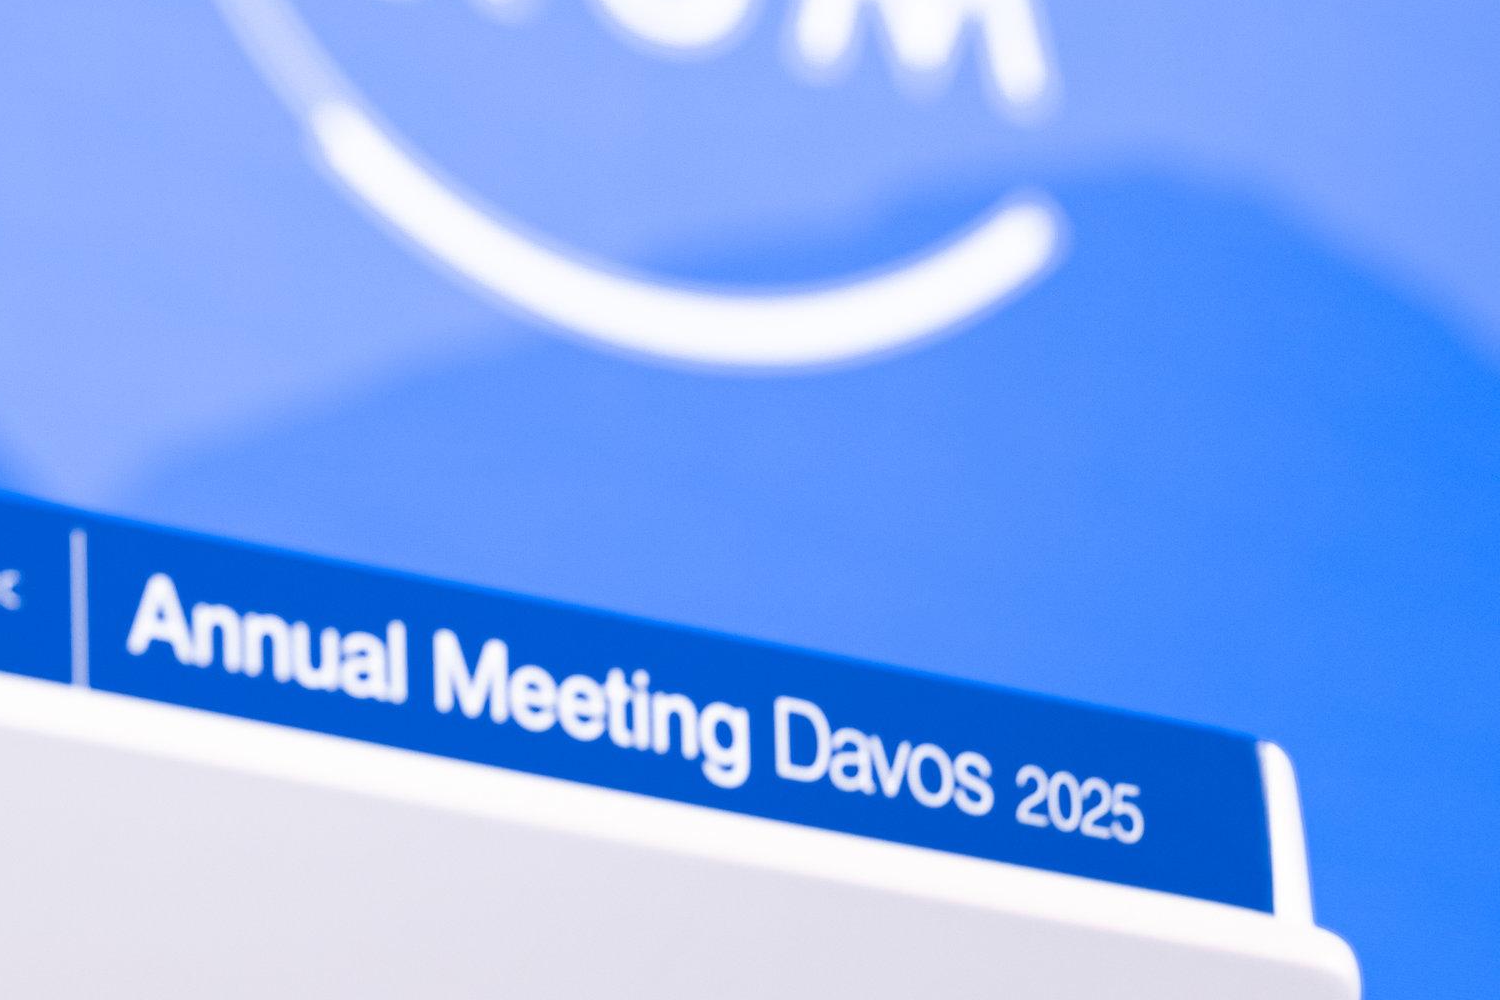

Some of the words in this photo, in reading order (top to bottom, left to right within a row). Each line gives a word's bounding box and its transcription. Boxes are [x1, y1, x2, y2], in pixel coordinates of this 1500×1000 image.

[127, 573, 408, 704] Annual
[433, 628, 751, 788] Meeting
[774, 695, 994, 816] Davos
[1015, 764, 1144, 844] 2025
